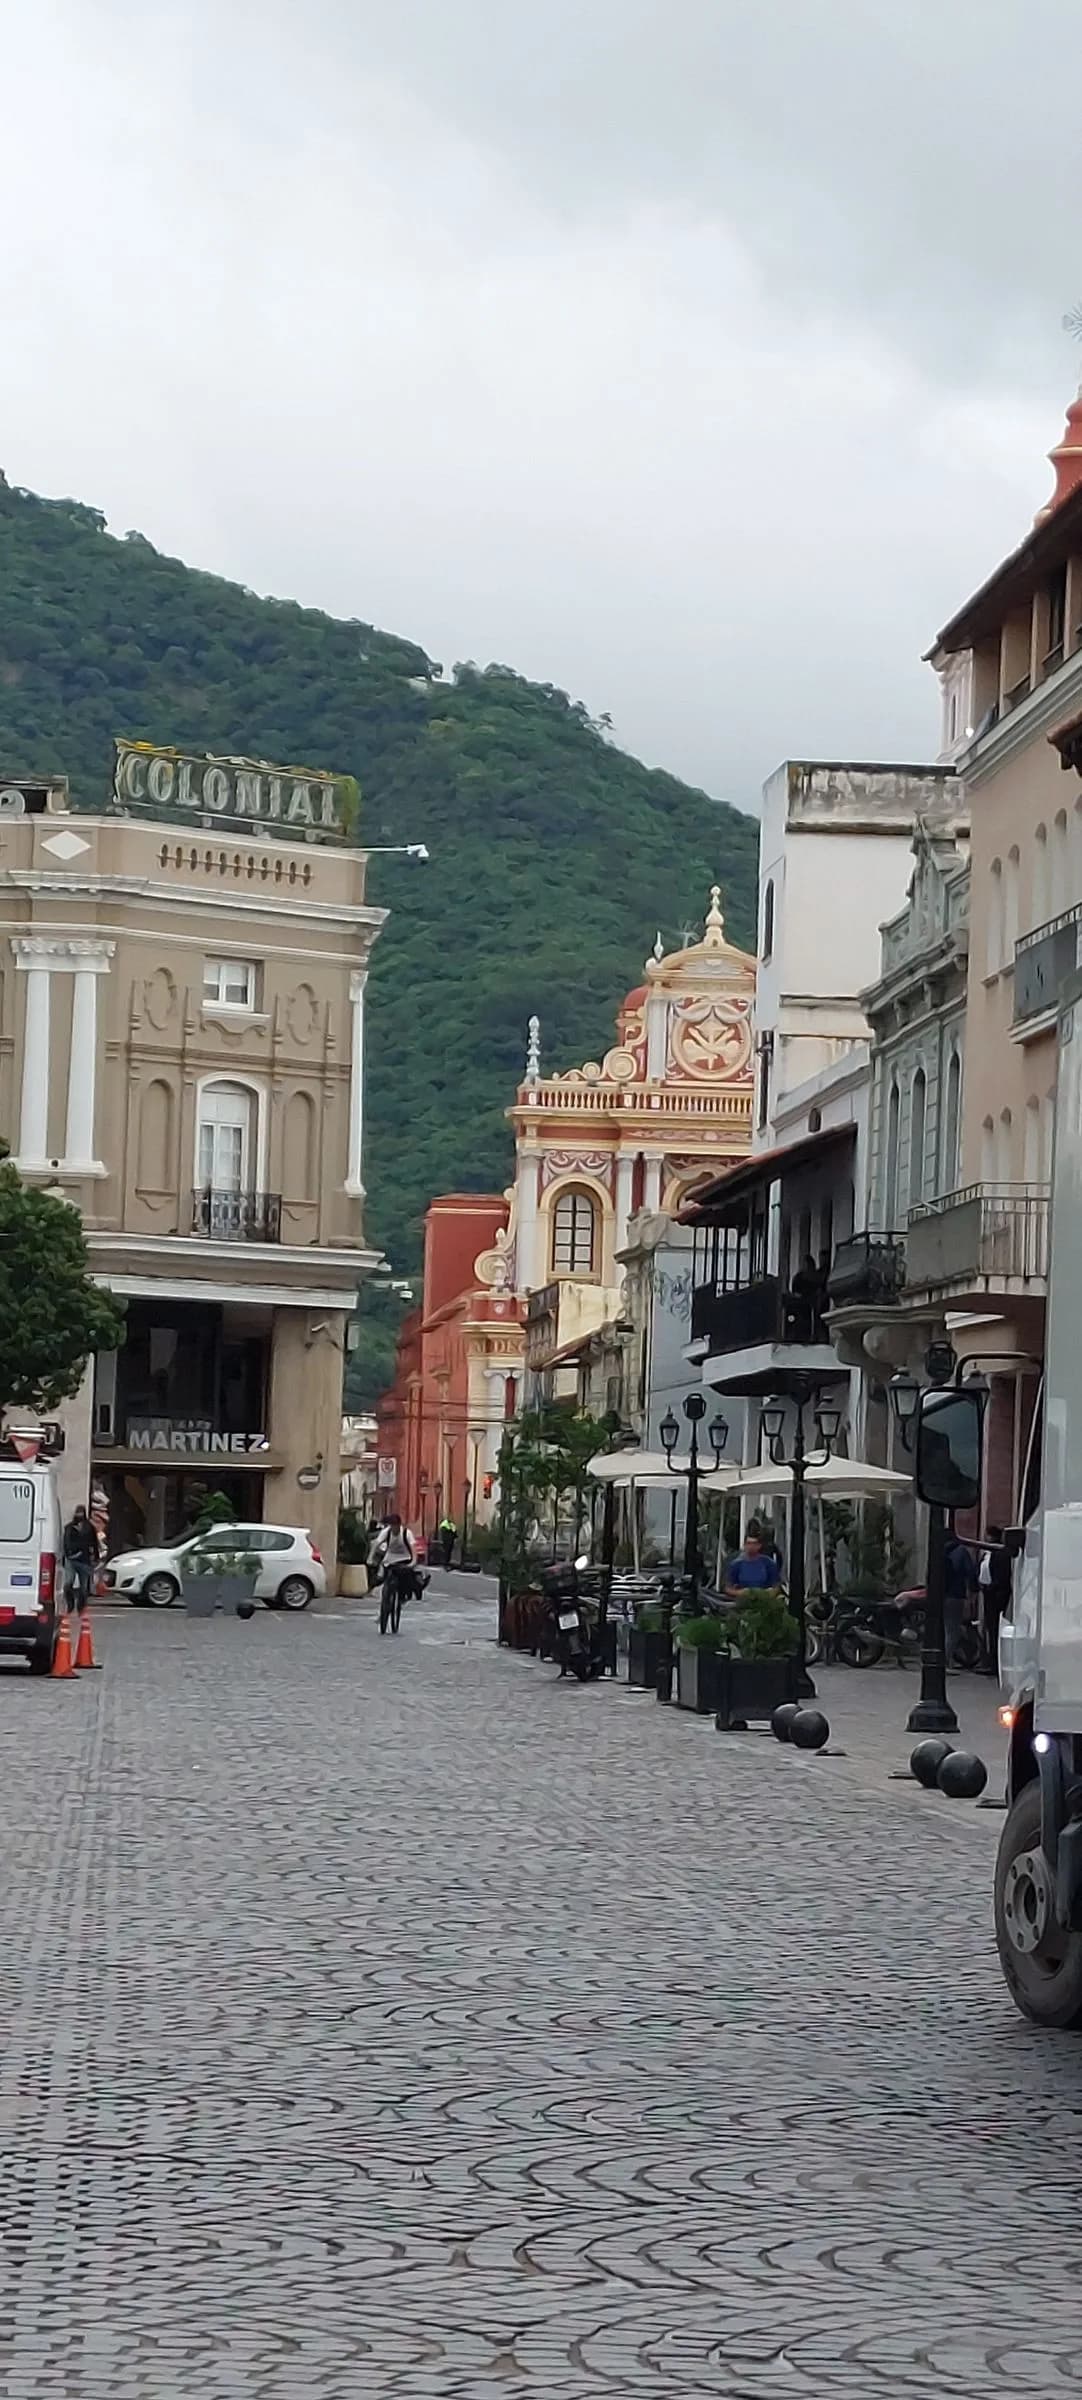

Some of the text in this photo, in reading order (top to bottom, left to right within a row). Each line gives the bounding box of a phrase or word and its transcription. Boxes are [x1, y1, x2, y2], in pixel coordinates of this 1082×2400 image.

[124, 753, 344, 827] COLONIAL
[129, 1430, 266, 1453] MARTINEZ
[13, 1485, 30, 1498] 110
